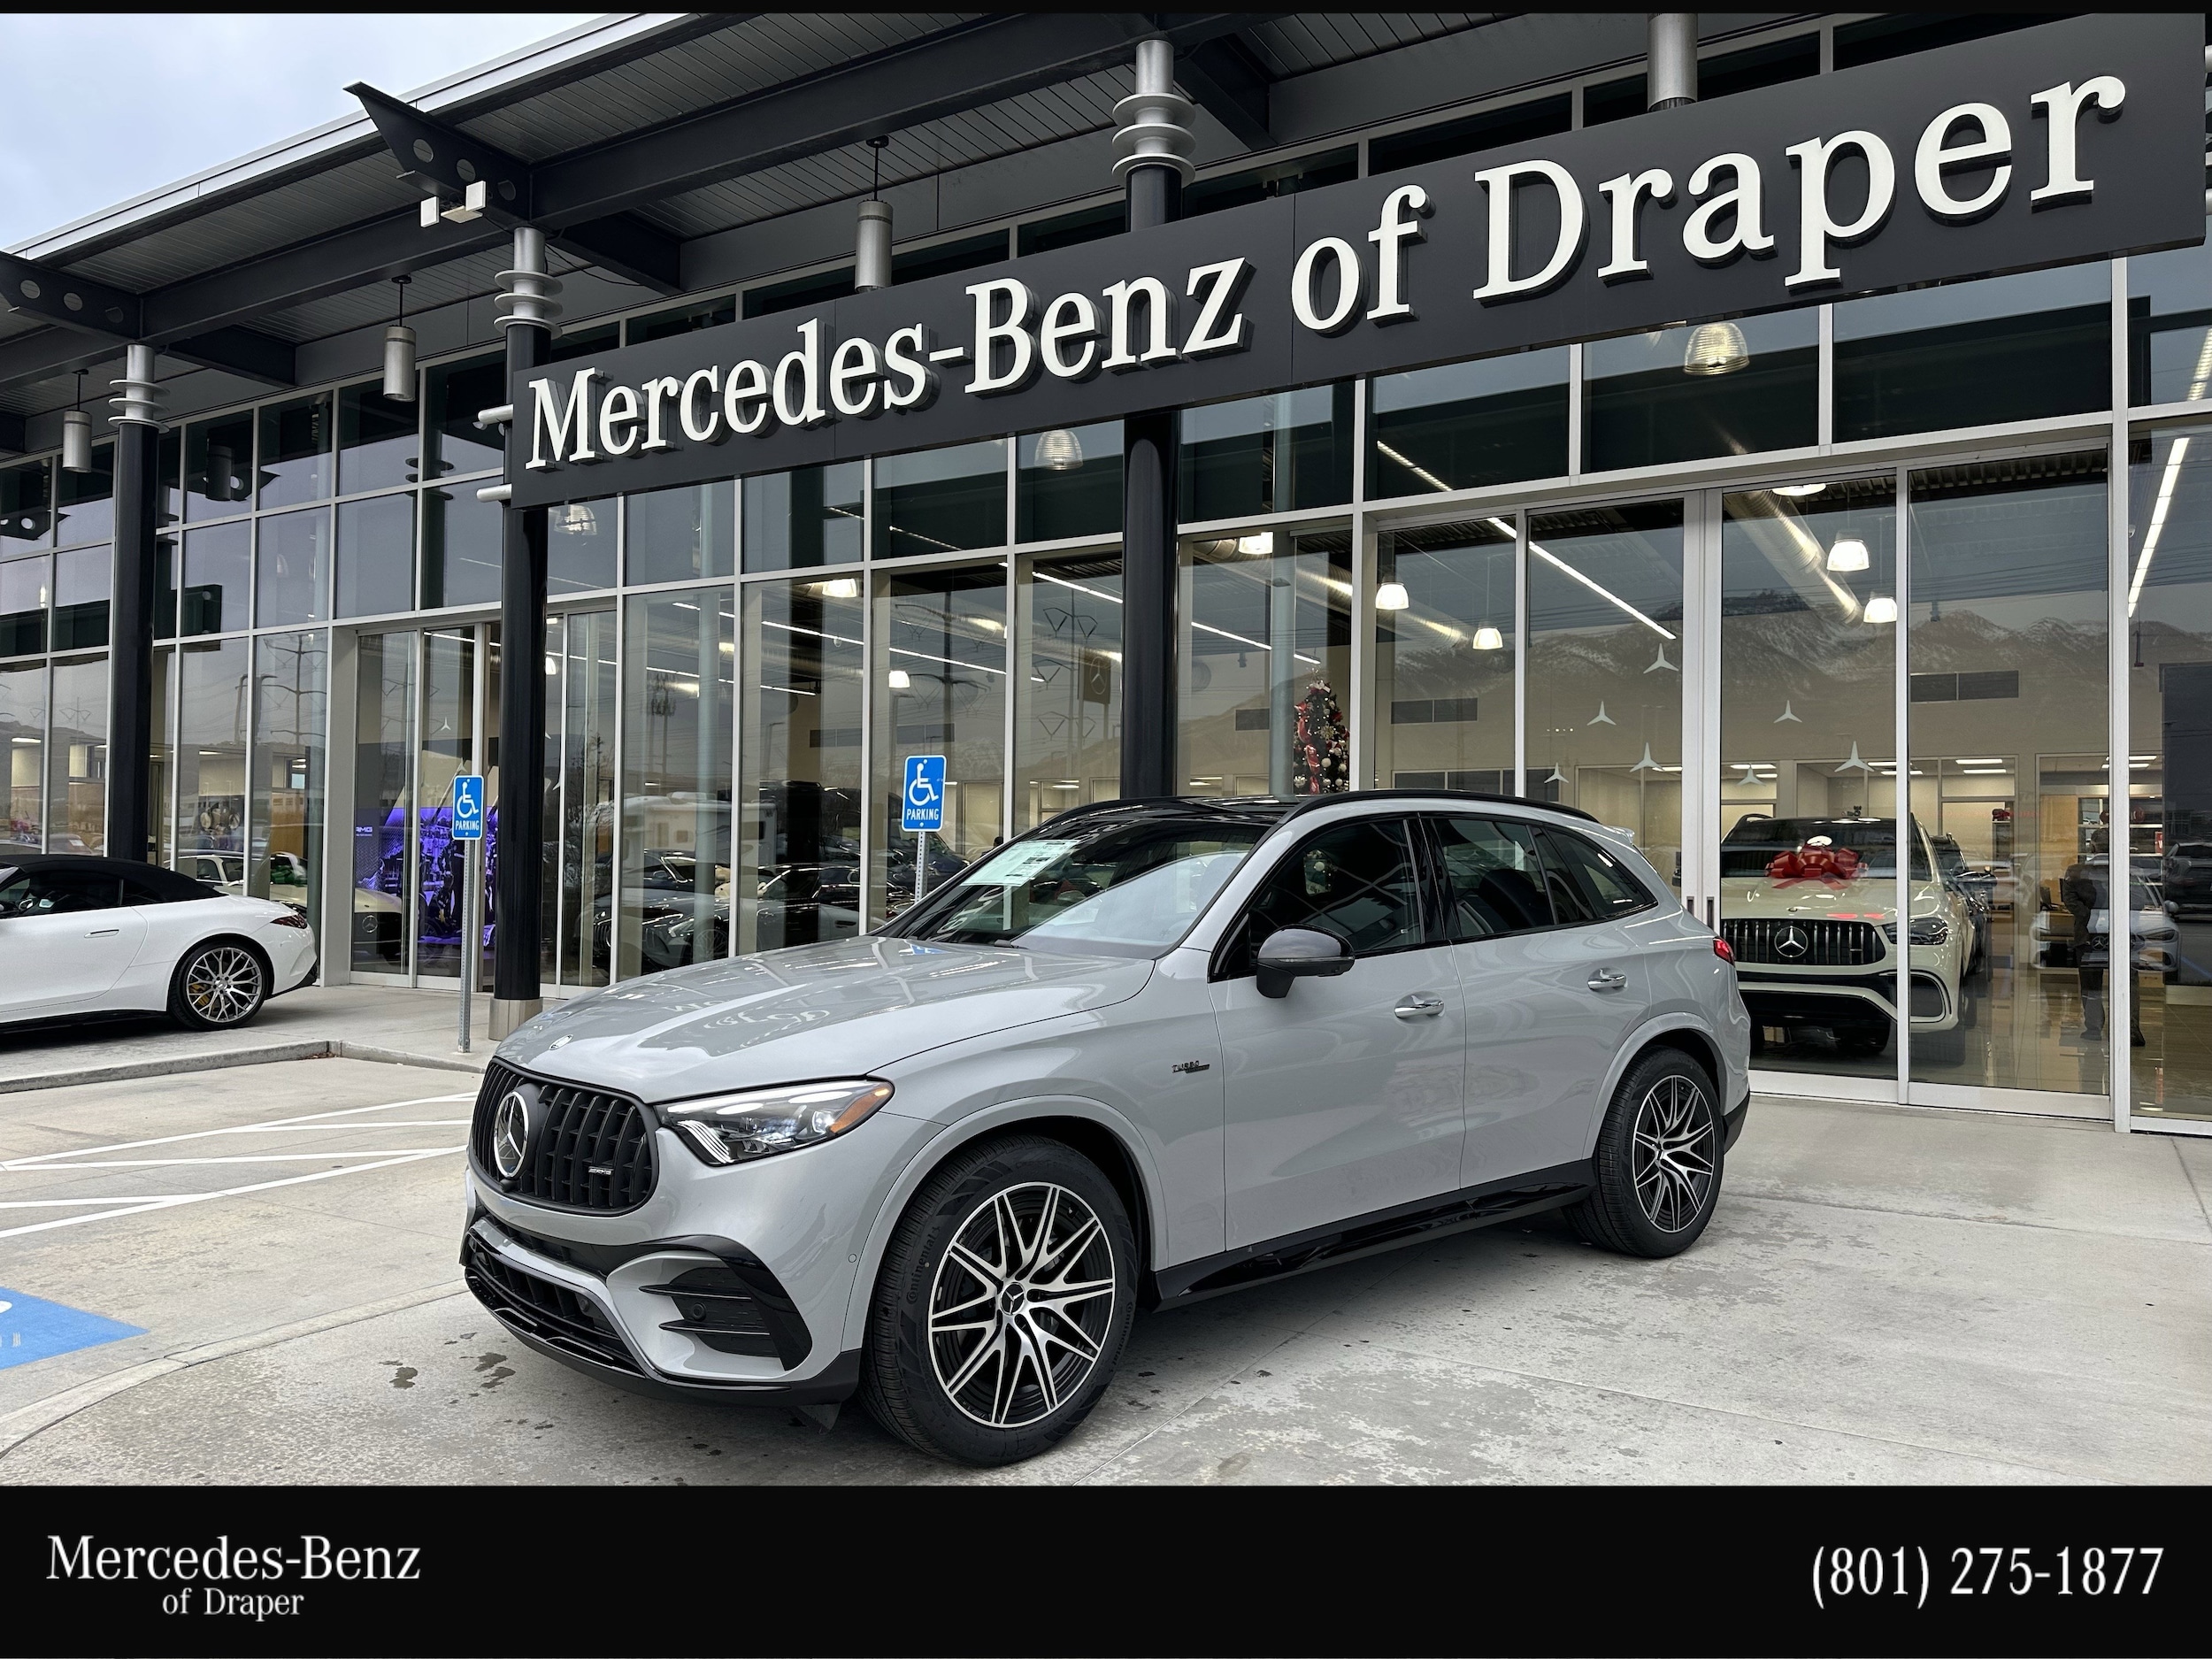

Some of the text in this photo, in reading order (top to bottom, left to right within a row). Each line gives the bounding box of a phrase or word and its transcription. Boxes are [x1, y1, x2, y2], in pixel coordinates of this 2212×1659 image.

[525, 75, 2128, 471] Mercedes-Benz of Draper
[455, 819, 480, 832] PARKING
[906, 808, 940, 821] PARKING
[906, 1233, 937, 1305] Continental
